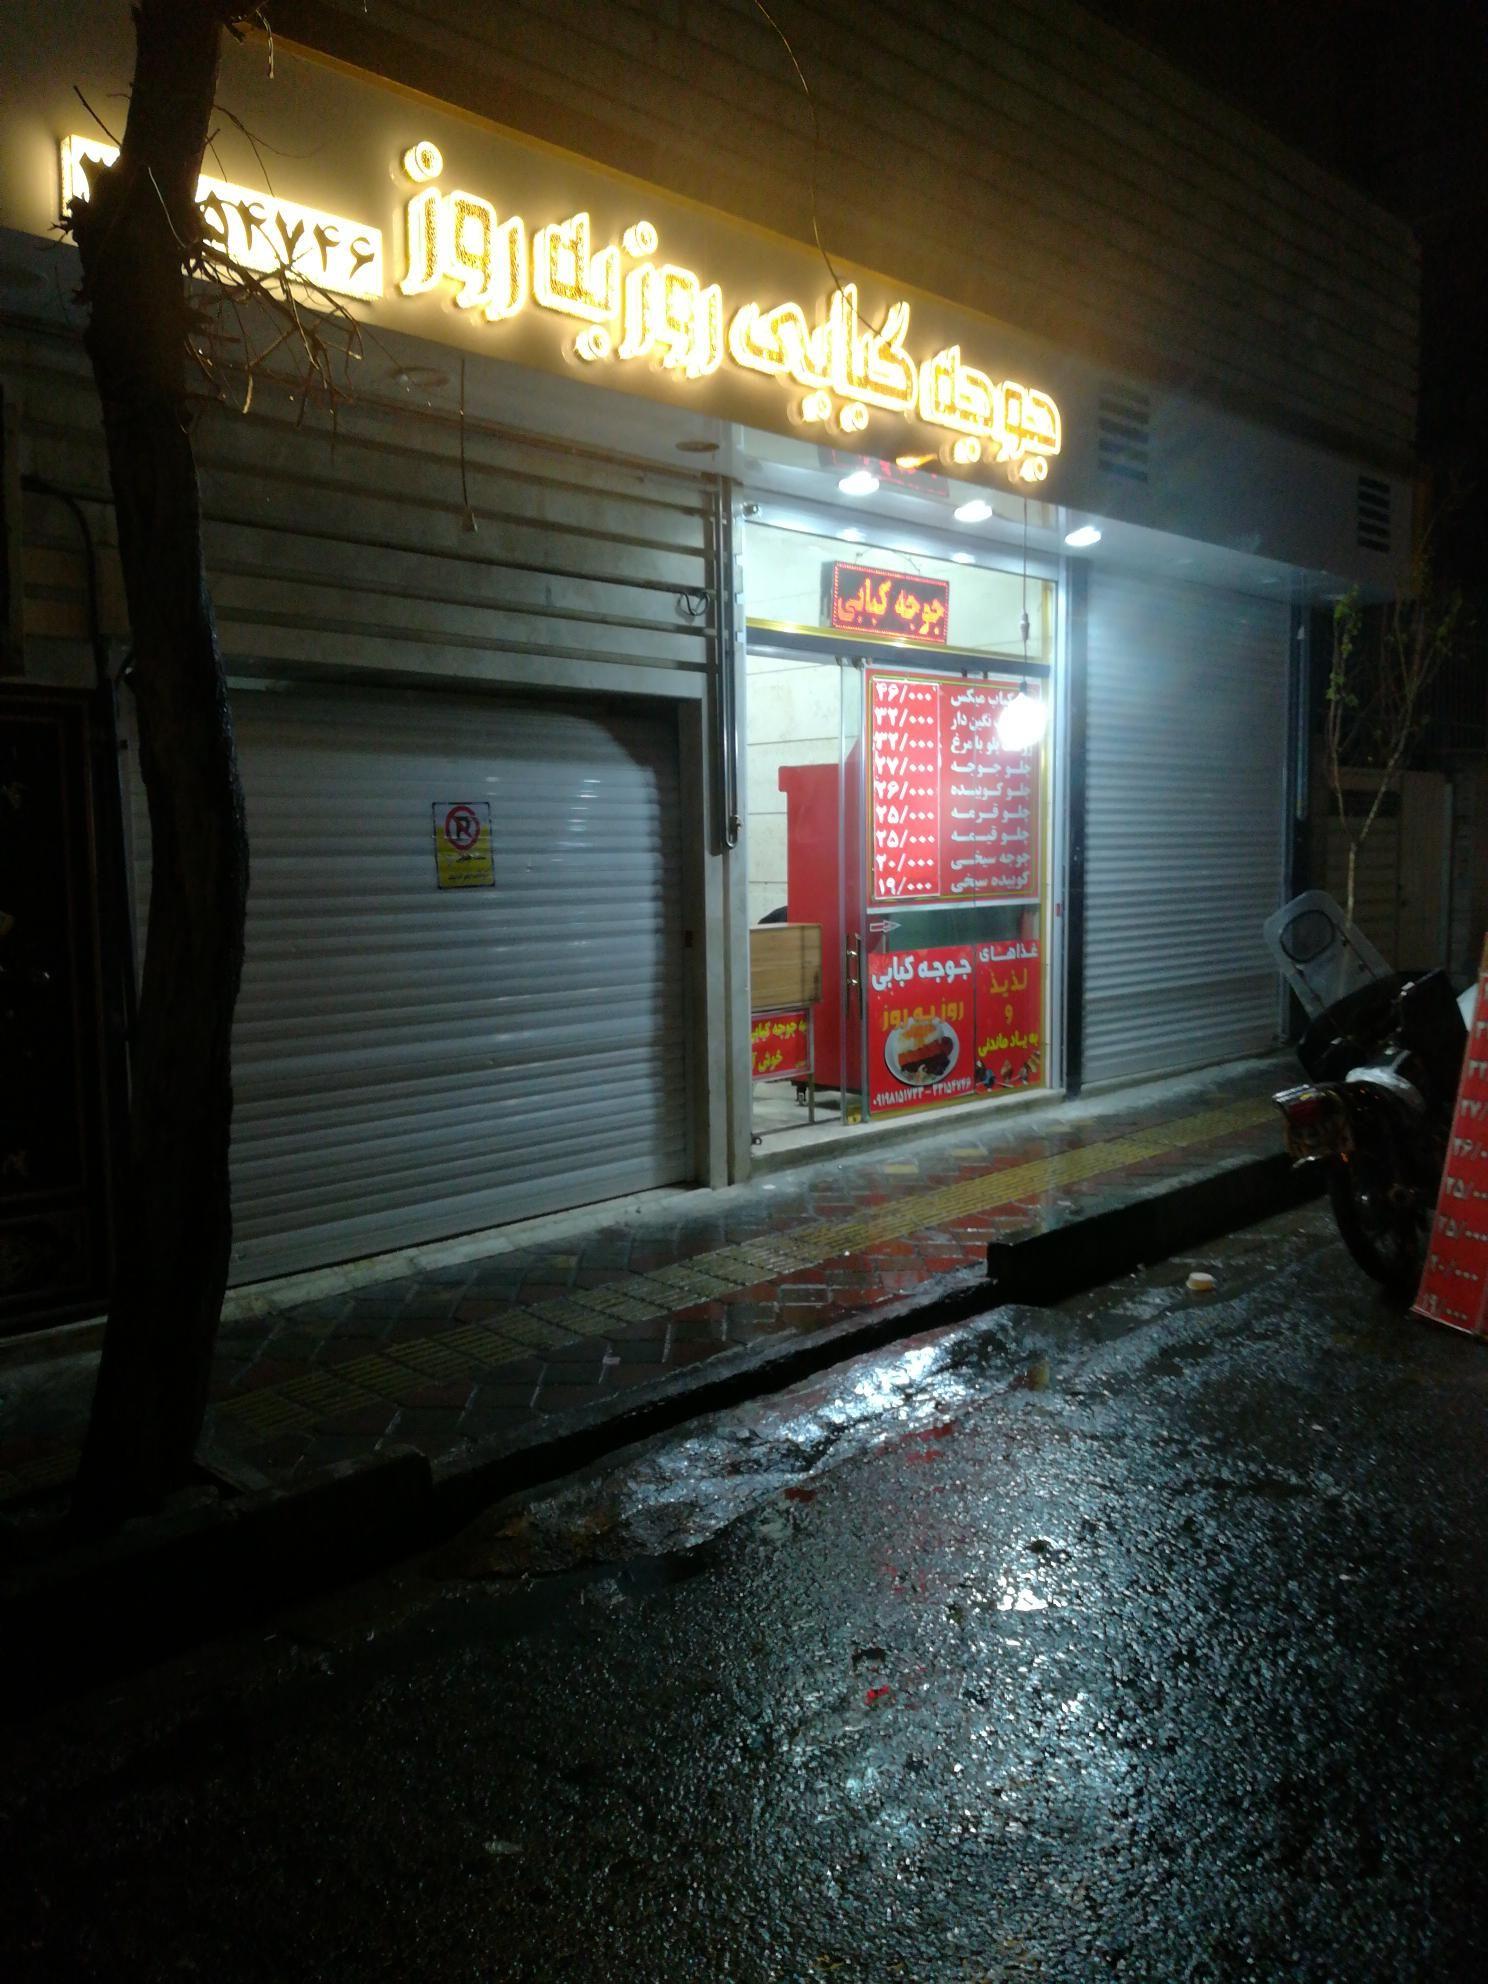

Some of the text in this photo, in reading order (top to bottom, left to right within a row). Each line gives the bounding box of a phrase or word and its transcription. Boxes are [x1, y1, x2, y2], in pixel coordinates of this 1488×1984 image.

[398, 139, 1063, 484] جوجه کبابی روز به روز
[837, 575, 946, 636] جوجه کبابی
[950, 711, 968, 730] دار
[950, 733, 973, 754] مرغ
[978, 942, 1039, 962] غذاهای
[871, 954, 972, 991] جوجه کبابی
[989, 967, 1028, 997] لذیذ
[881, 1004, 909, 1031] روز
[940, 997, 964, 1021] روز
[1004, 1003, 1013, 1025] و
[772, 1022, 797, 1039] جوجه
[757, 1049, 783, 1072] خوش
